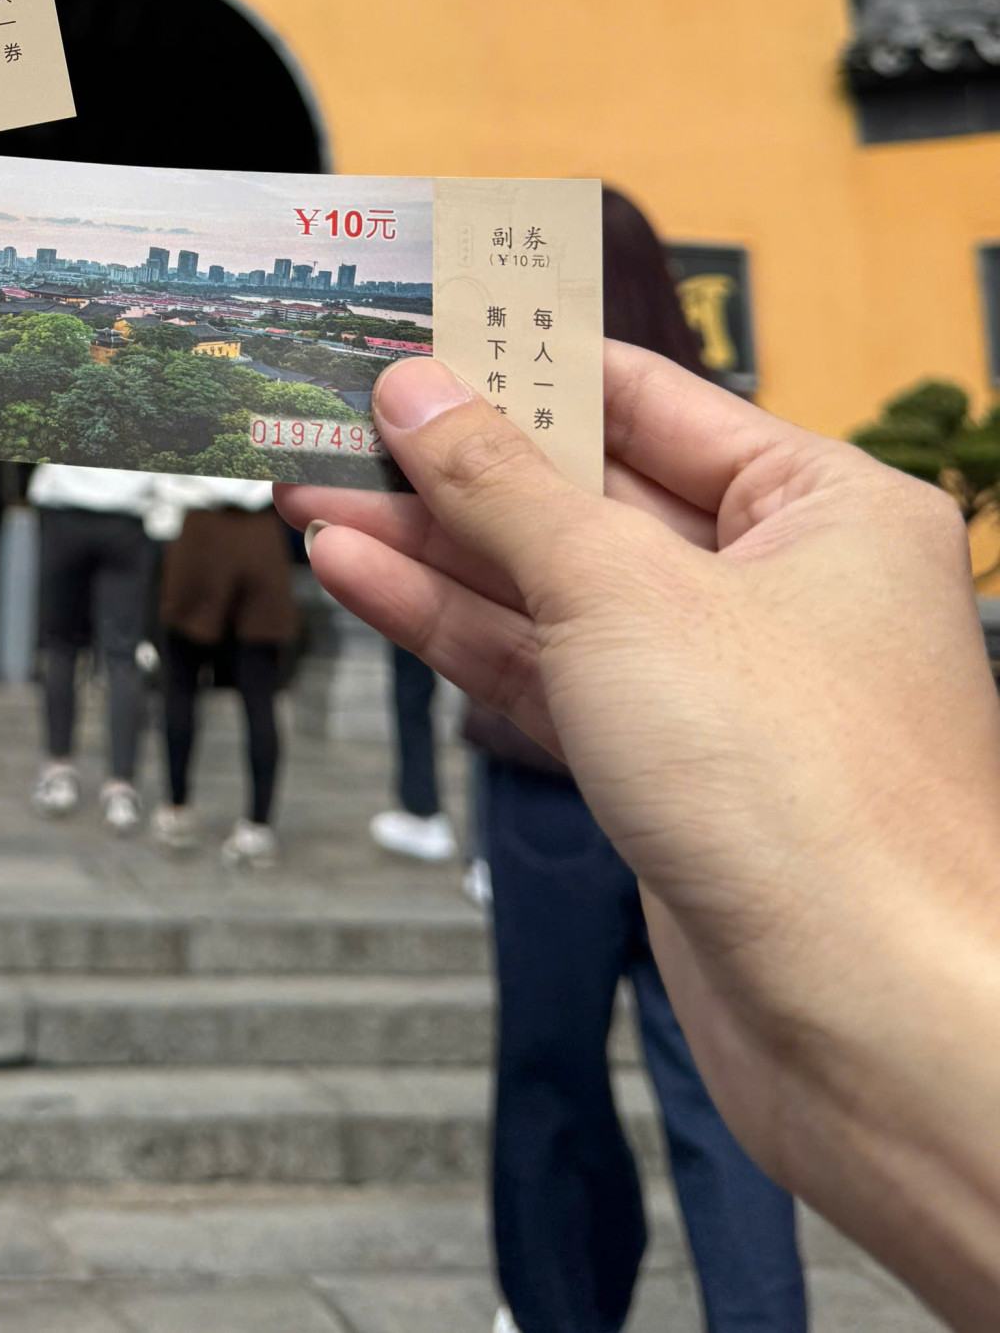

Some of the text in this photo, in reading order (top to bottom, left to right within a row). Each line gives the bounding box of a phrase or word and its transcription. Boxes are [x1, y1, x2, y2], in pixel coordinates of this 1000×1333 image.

[293, 207, 397, 240] ¥10元
[491, 226, 547, 251] 副券
[487, 306, 507, 415] 撕下作
[533, 308, 554, 430] 每人一券
[252, 420, 382, 454] 0197492
